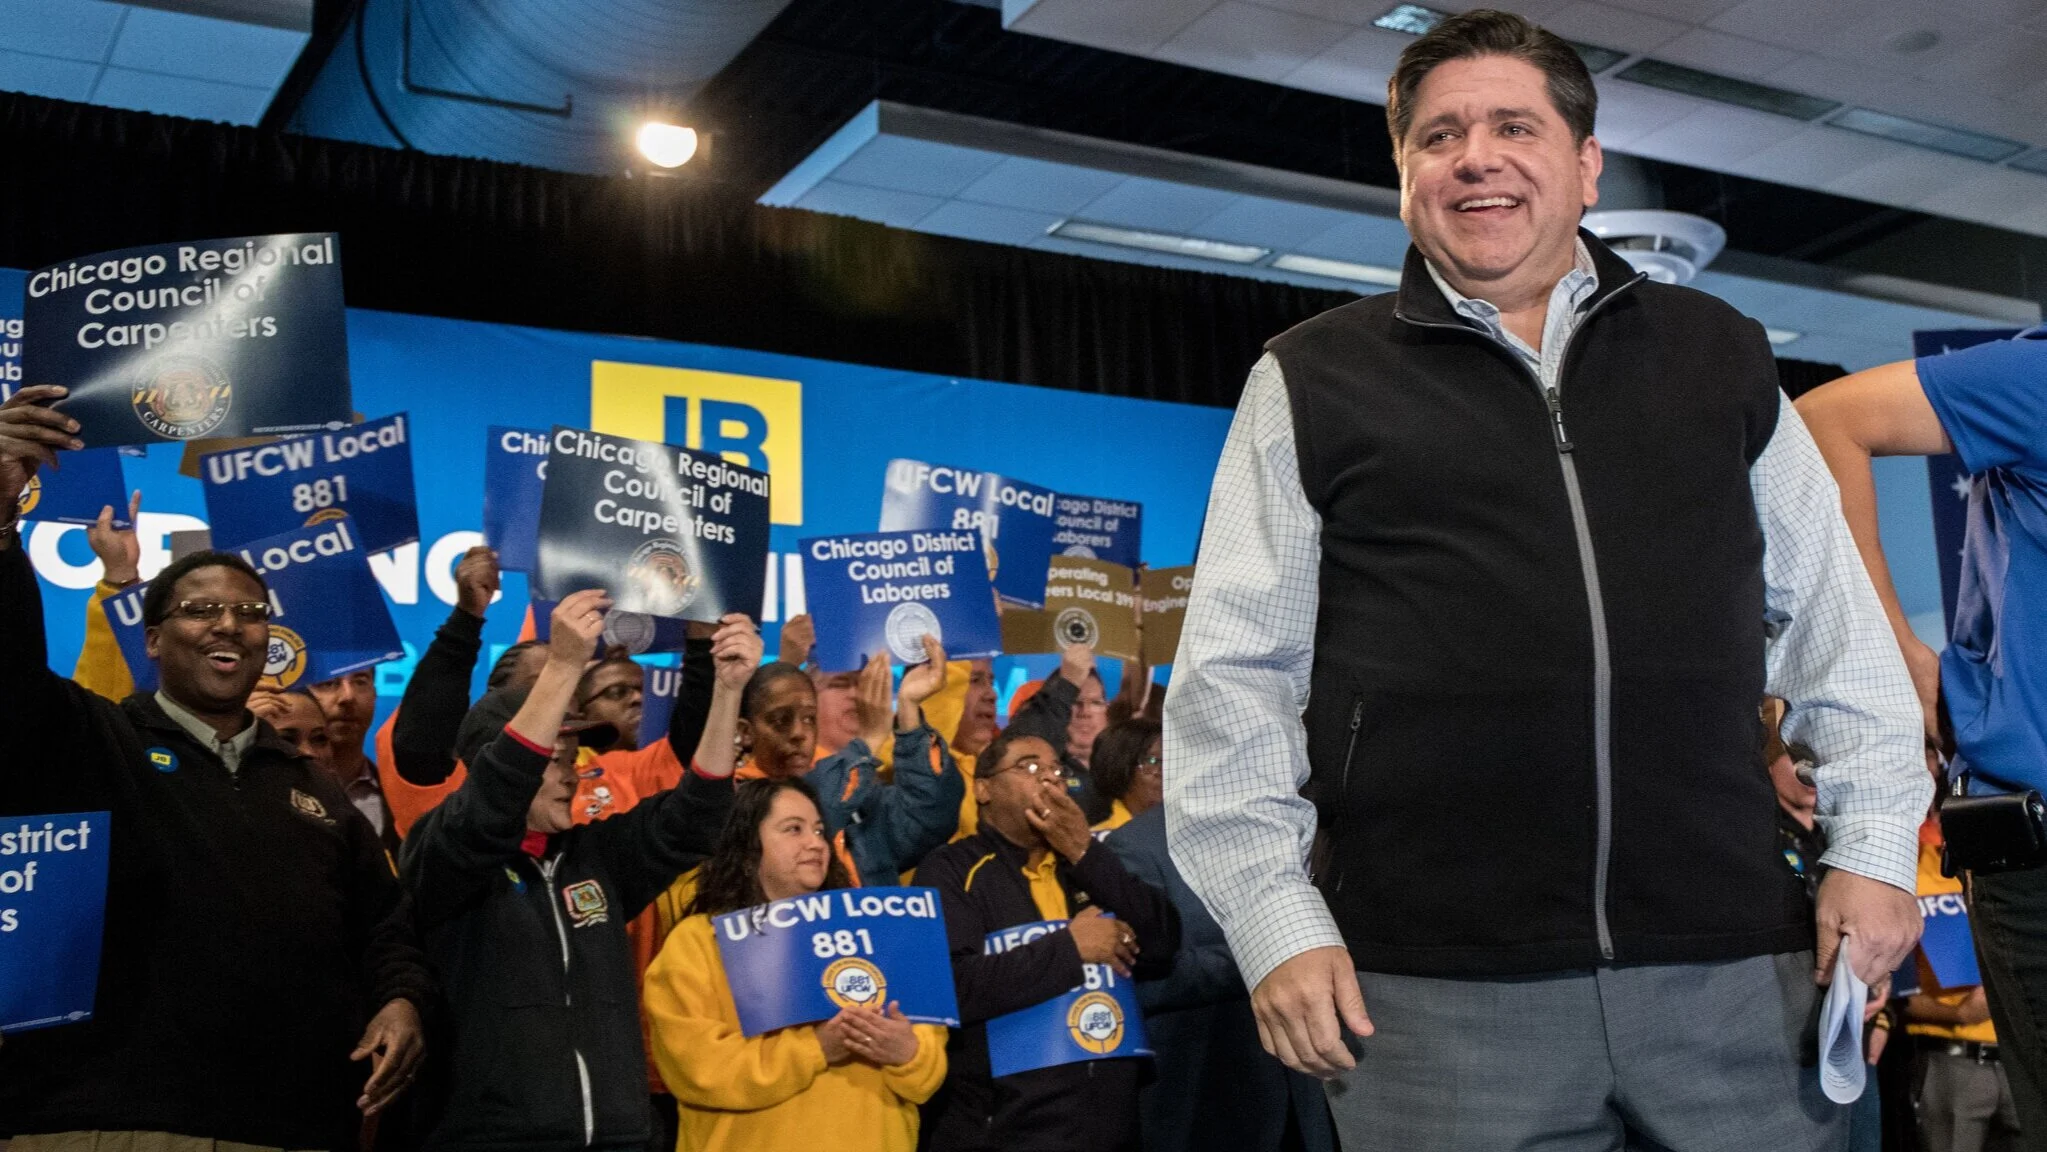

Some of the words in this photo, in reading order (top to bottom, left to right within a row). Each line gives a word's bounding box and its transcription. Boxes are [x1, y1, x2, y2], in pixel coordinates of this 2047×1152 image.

[29, 255, 166, 298] Chicago
[178, 237, 334, 275] Regional
[85, 278, 220, 315] Council
[234, 275, 266, 302] of
[77, 315, 277, 349] Carpenters
[208, 439, 315, 484] UFCW
[323, 416, 405, 462] Local
[554, 429, 670, 473] Chicago
[678, 452, 769, 497] Regional
[293, 475, 347, 512] 881
[603, 469, 705, 508] Council
[710, 492, 732, 515] of
[892, 464, 981, 498] UFCW
[989, 480, 1054, 517] Local
[594, 499, 736, 544] Carpenters
[1053, 530, 1111, 547] aborers
[241, 522, 354, 575] Local
[812, 539, 907, 560] Chicago
[913, 533, 975, 552] District
[849, 560, 930, 581] Council
[935, 555, 954, 575] of
[861, 583, 951, 604] Laborers
[1077, 586, 1113, 603] Local
[0, 861, 38, 894] of
[841, 891, 936, 919] Local
[812, 928, 874, 959] 881
[1070, 963, 1115, 992] 81
